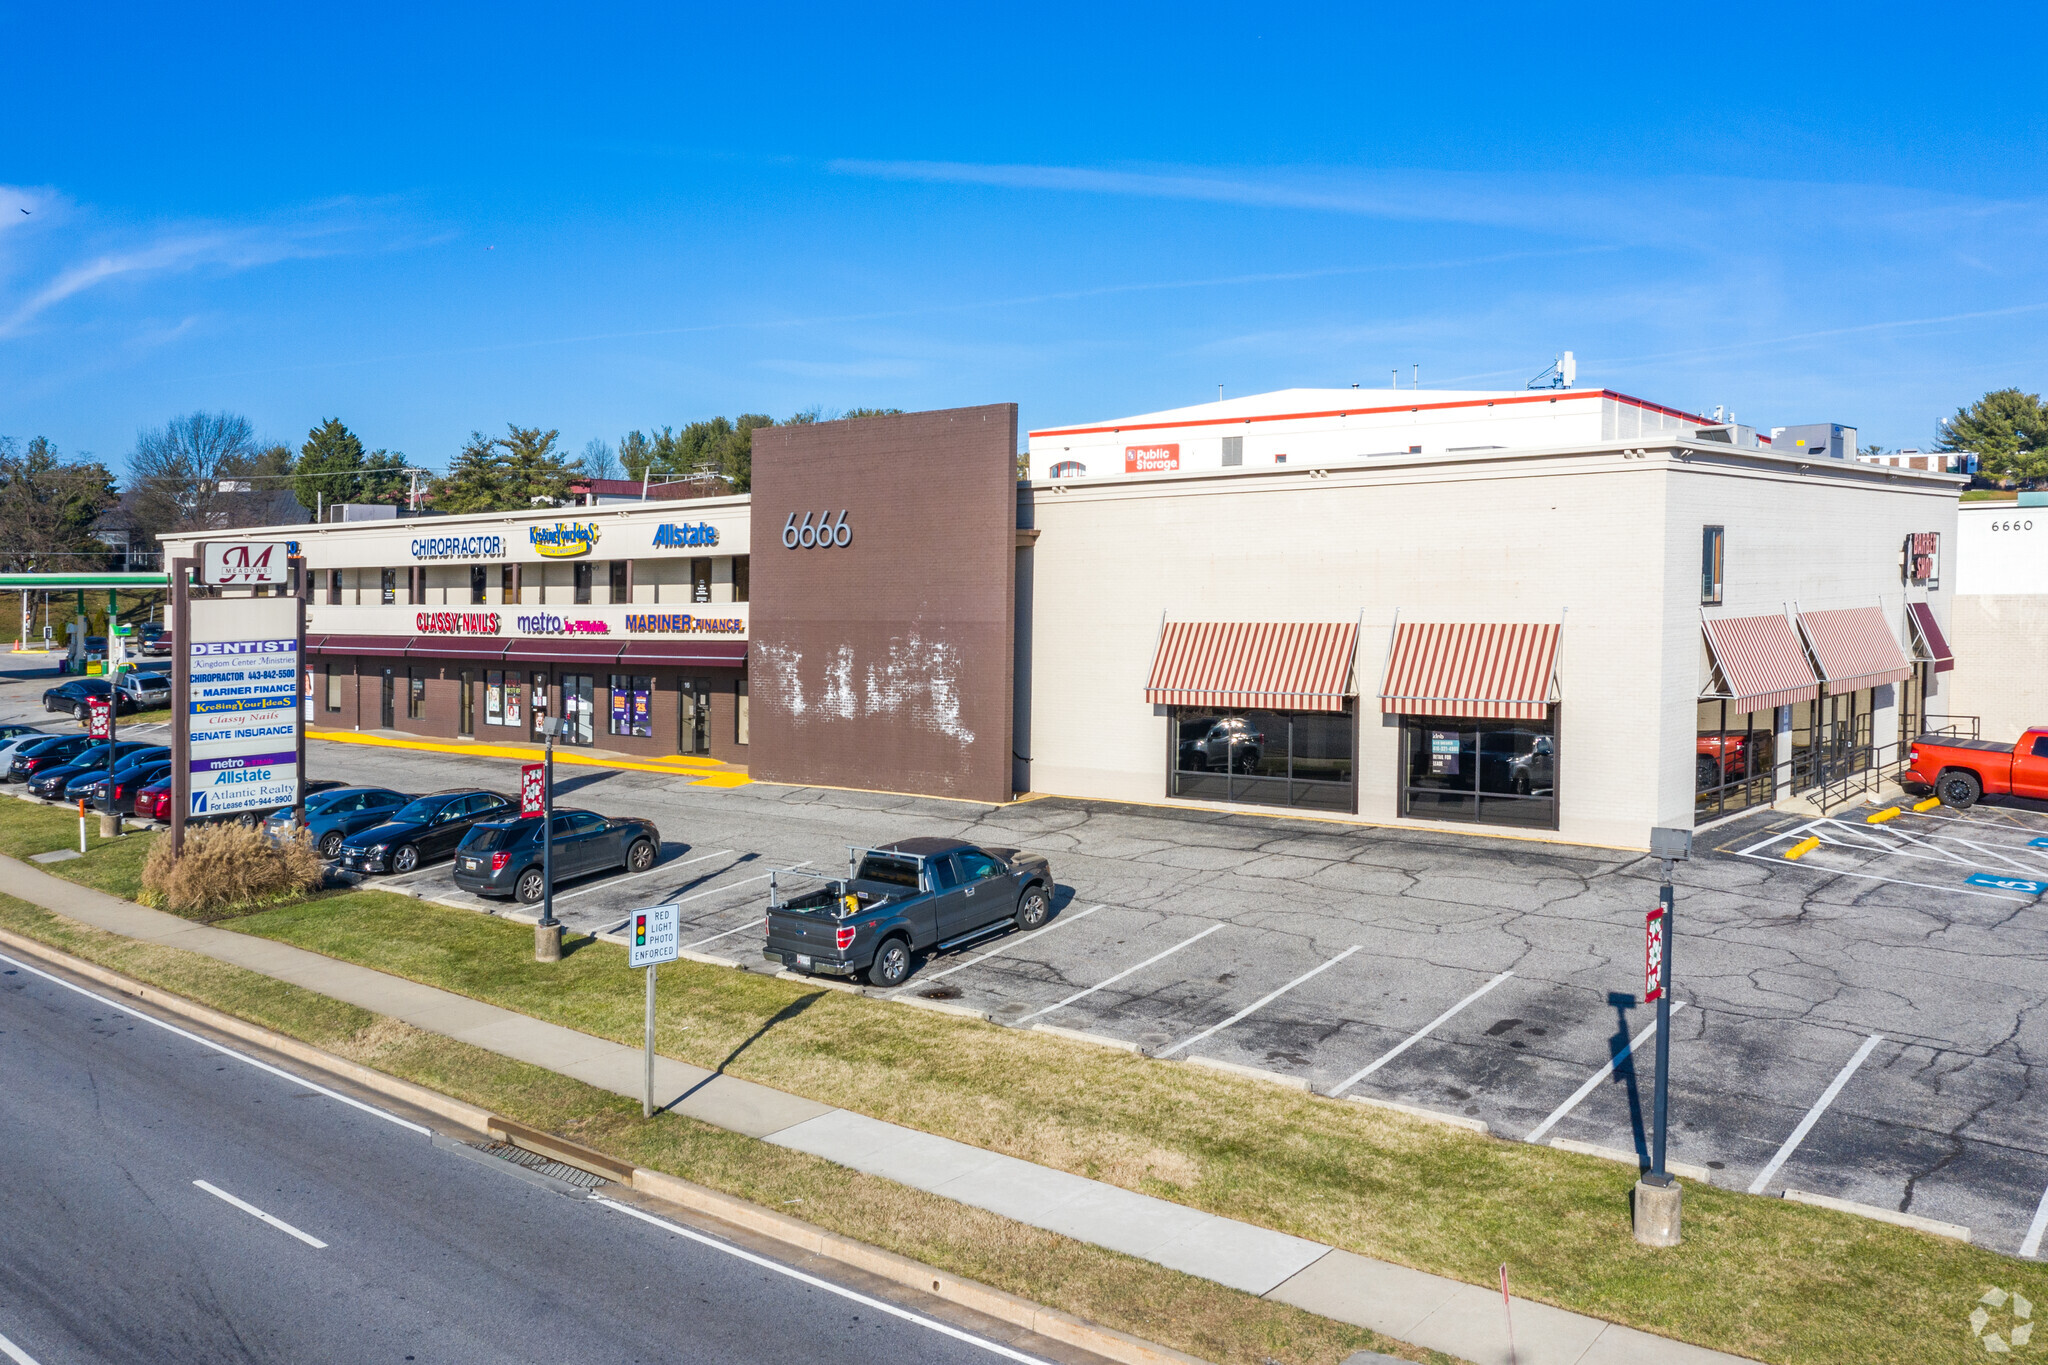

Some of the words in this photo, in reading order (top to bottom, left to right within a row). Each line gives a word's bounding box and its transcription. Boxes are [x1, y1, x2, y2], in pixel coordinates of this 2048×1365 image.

[1137, 449, 1169, 459] Public
[1137, 460, 1177, 471] Storage
[782, 509, 852, 548] 6666
[1991, 520, 2033, 532] 6660
[652, 521, 715, 546] Allstate
[411, 536, 500, 556] CHIROPRACTOR
[1917, 557, 1933, 579] SHOP
[416, 612, 458, 631] CLASSY
[462, 612, 496, 632] NAILS
[517, 612, 561, 632] metro
[625, 614, 691, 630] MARINER
[695, 618, 741, 630] FINANCE
[190, 641, 293, 655] DENTIST
[193, 660, 230, 669] Kingdom
[231, 658, 256, 667] Center
[258, 656, 296, 666] Ministries
[190, 671, 245, 684] CHIROPRACTOR
[248, 669, 295, 680] 443-842-5500
[203, 686, 252, 697] MARINER
[253, 684, 296, 694] FINANCE
[209, 715, 246, 726] Classy
[249, 712, 279, 721] Nails
[190, 731, 232, 742] SENATE
[234, 725, 293, 738] INSURANCE
[210, 758, 244, 770] metro
[214, 768, 271, 785] Allstate
[210, 788, 257, 801] Atlantic
[260, 783, 295, 796] Realty
[210, 801, 222, 811] For
[222, 800, 243, 809] Lease
[243, 794, 293, 807] 410-944-8900
[655, 911, 670, 920] RED
[651, 922, 672, 933] LIGHT
[650, 933, 673, 944] PHOTO
[635, 947, 673, 960] ENFORCED
